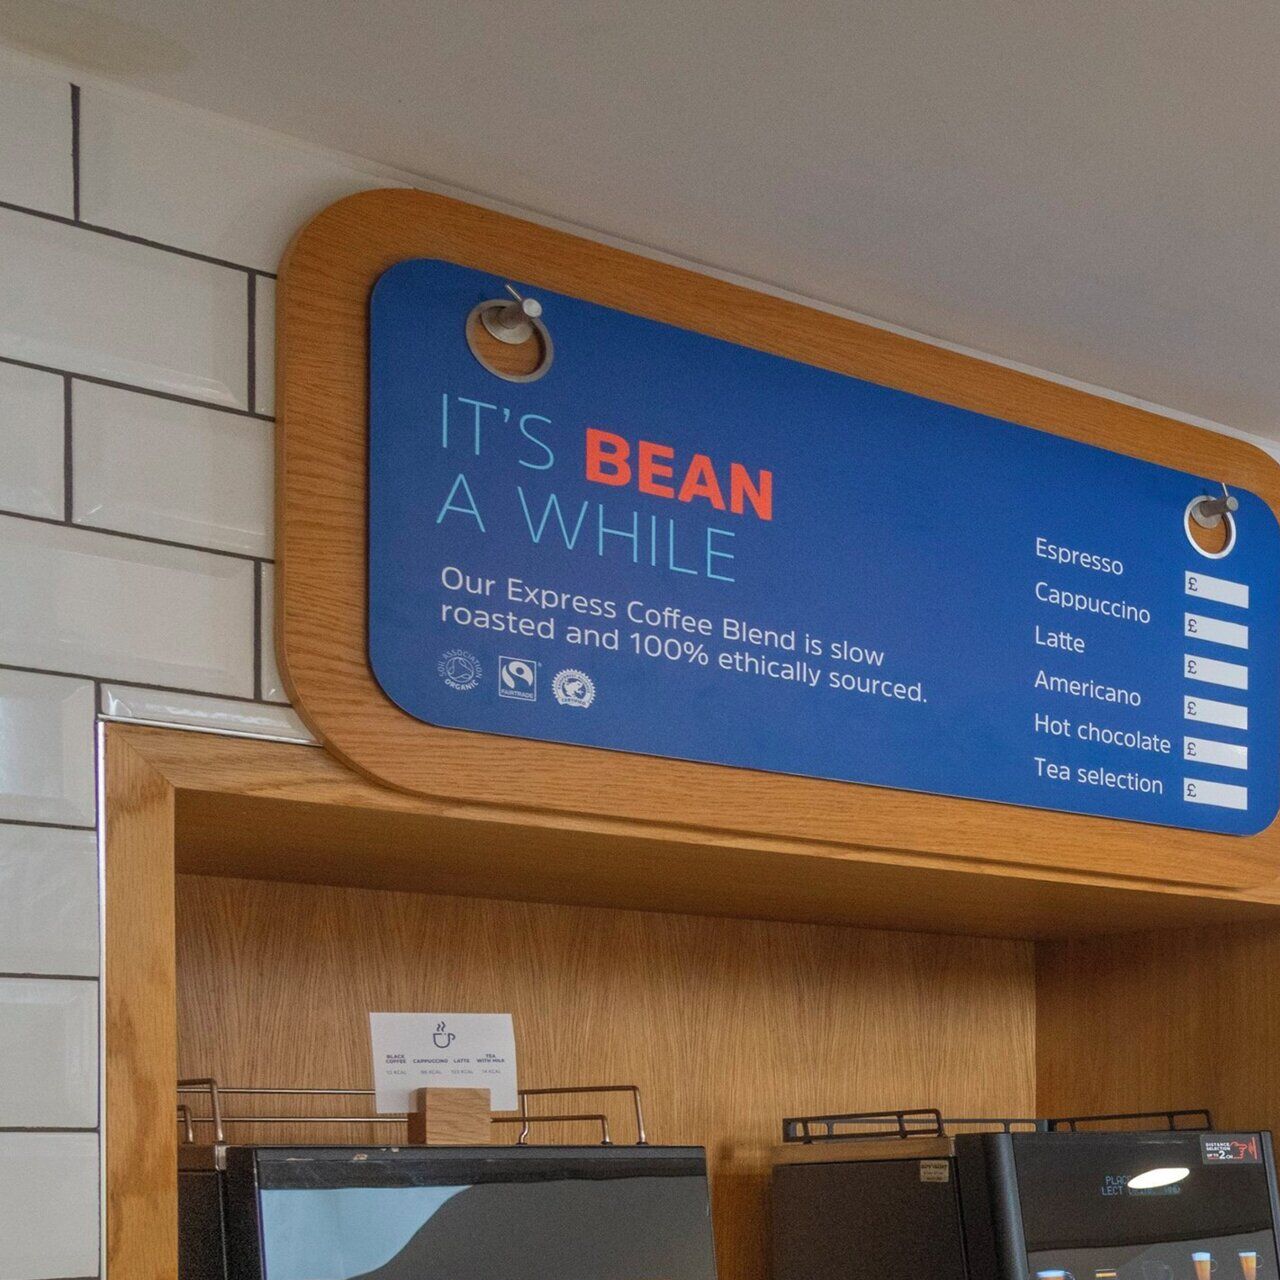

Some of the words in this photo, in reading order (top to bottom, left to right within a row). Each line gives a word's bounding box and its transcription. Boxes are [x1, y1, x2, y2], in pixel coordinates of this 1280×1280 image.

[442, 393, 555, 470] IT'S
[585, 427, 774, 521] BEAN
[436, 473, 486, 533] A
[517, 486, 736, 583] WHILE
[1036, 537, 1124, 576] Espresso
[441, 566, 496, 598] Our
[507, 578, 617, 620] Express
[627, 601, 713, 638] Coffee
[723, 618, 796, 652] Blend
[805, 632, 823, 657] is
[831, 640, 885, 667] slow
[1035, 581, 1151, 624] Cappuccino
[441, 601, 555, 640] roasted
[565, 623, 620, 651] and
[630, 632, 709, 667] 100%
[718, 647, 822, 687] ethically
[829, 666, 928, 704] sourced.
[1035, 625, 1086, 653] Latte
[443, 649, 484, 680] ASSOCIATION
[444, 678, 480, 691] ORGANIC
[501, 688, 534, 699] FAIRTRADE
[1034, 670, 1141, 707] Americano
[1035, 713, 1070, 738] Hot
[1078, 722, 1171, 754] chocolate
[1034, 757, 1070, 781] Tea
[1078, 768, 1163, 795] selection
[1219, 1151, 1226, 1159] 2
[1105, 1175, 1132, 1185] PLAC
